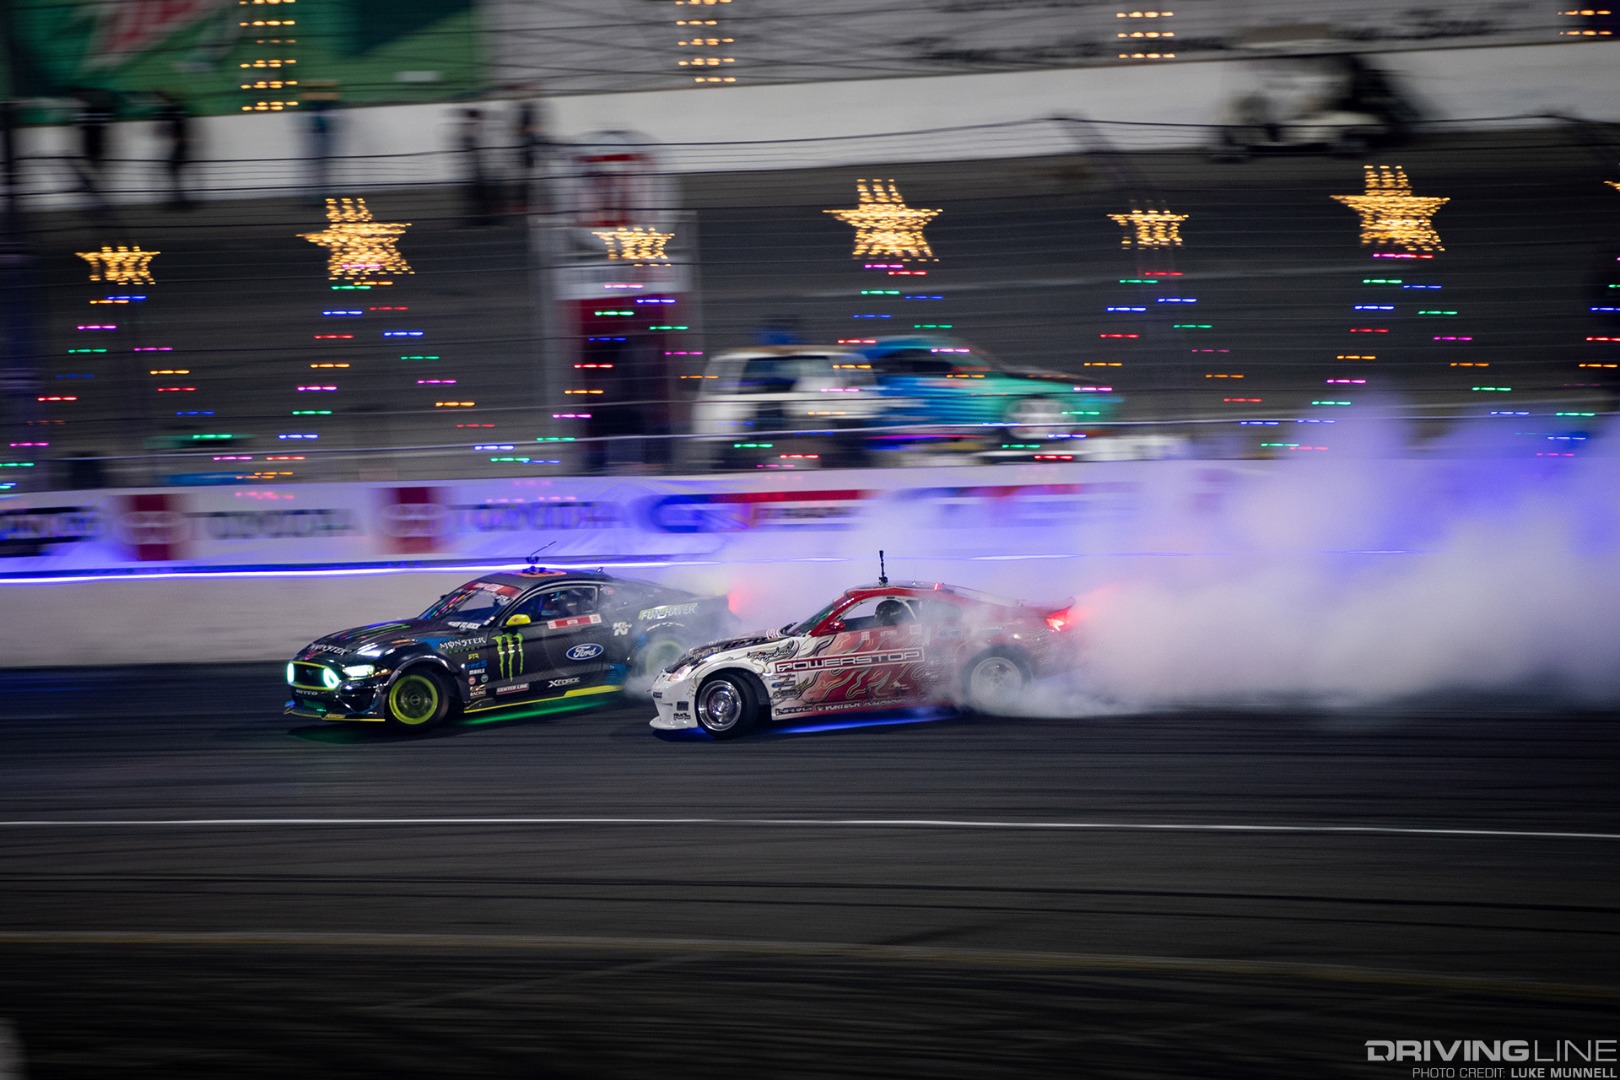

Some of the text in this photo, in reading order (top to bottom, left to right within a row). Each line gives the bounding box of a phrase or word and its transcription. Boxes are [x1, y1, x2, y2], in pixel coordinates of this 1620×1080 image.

[439, 636, 487, 650] MONSTER
[573, 645, 597, 658] Ford
[777, 652, 922, 671] POWERSTOP
